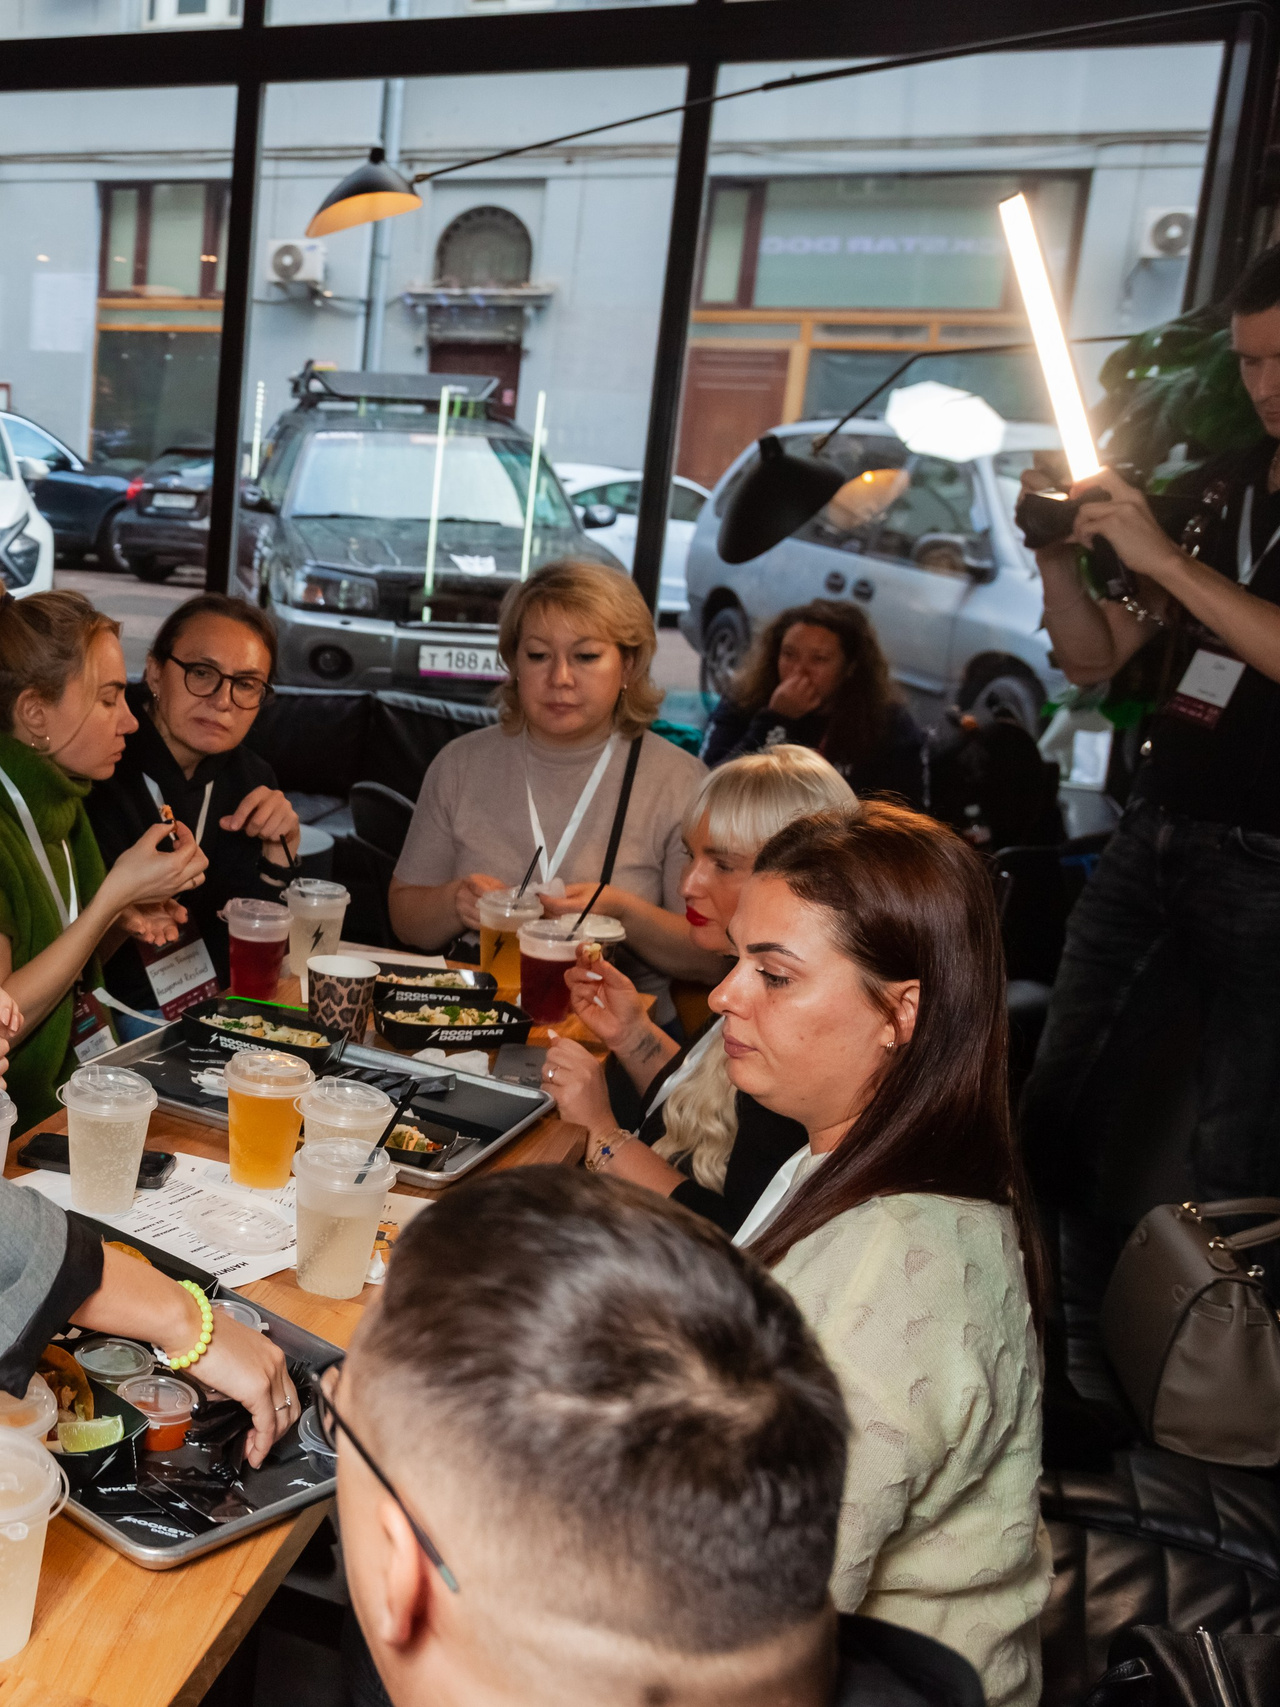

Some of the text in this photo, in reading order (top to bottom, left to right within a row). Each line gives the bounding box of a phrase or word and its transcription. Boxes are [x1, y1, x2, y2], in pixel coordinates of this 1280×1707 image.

[396, 991, 460, 1002] ROCKSTAR
[440, 1028, 504, 1036] ROCKSTAR
[127, 1517, 195, 1539] ROCKSTA
